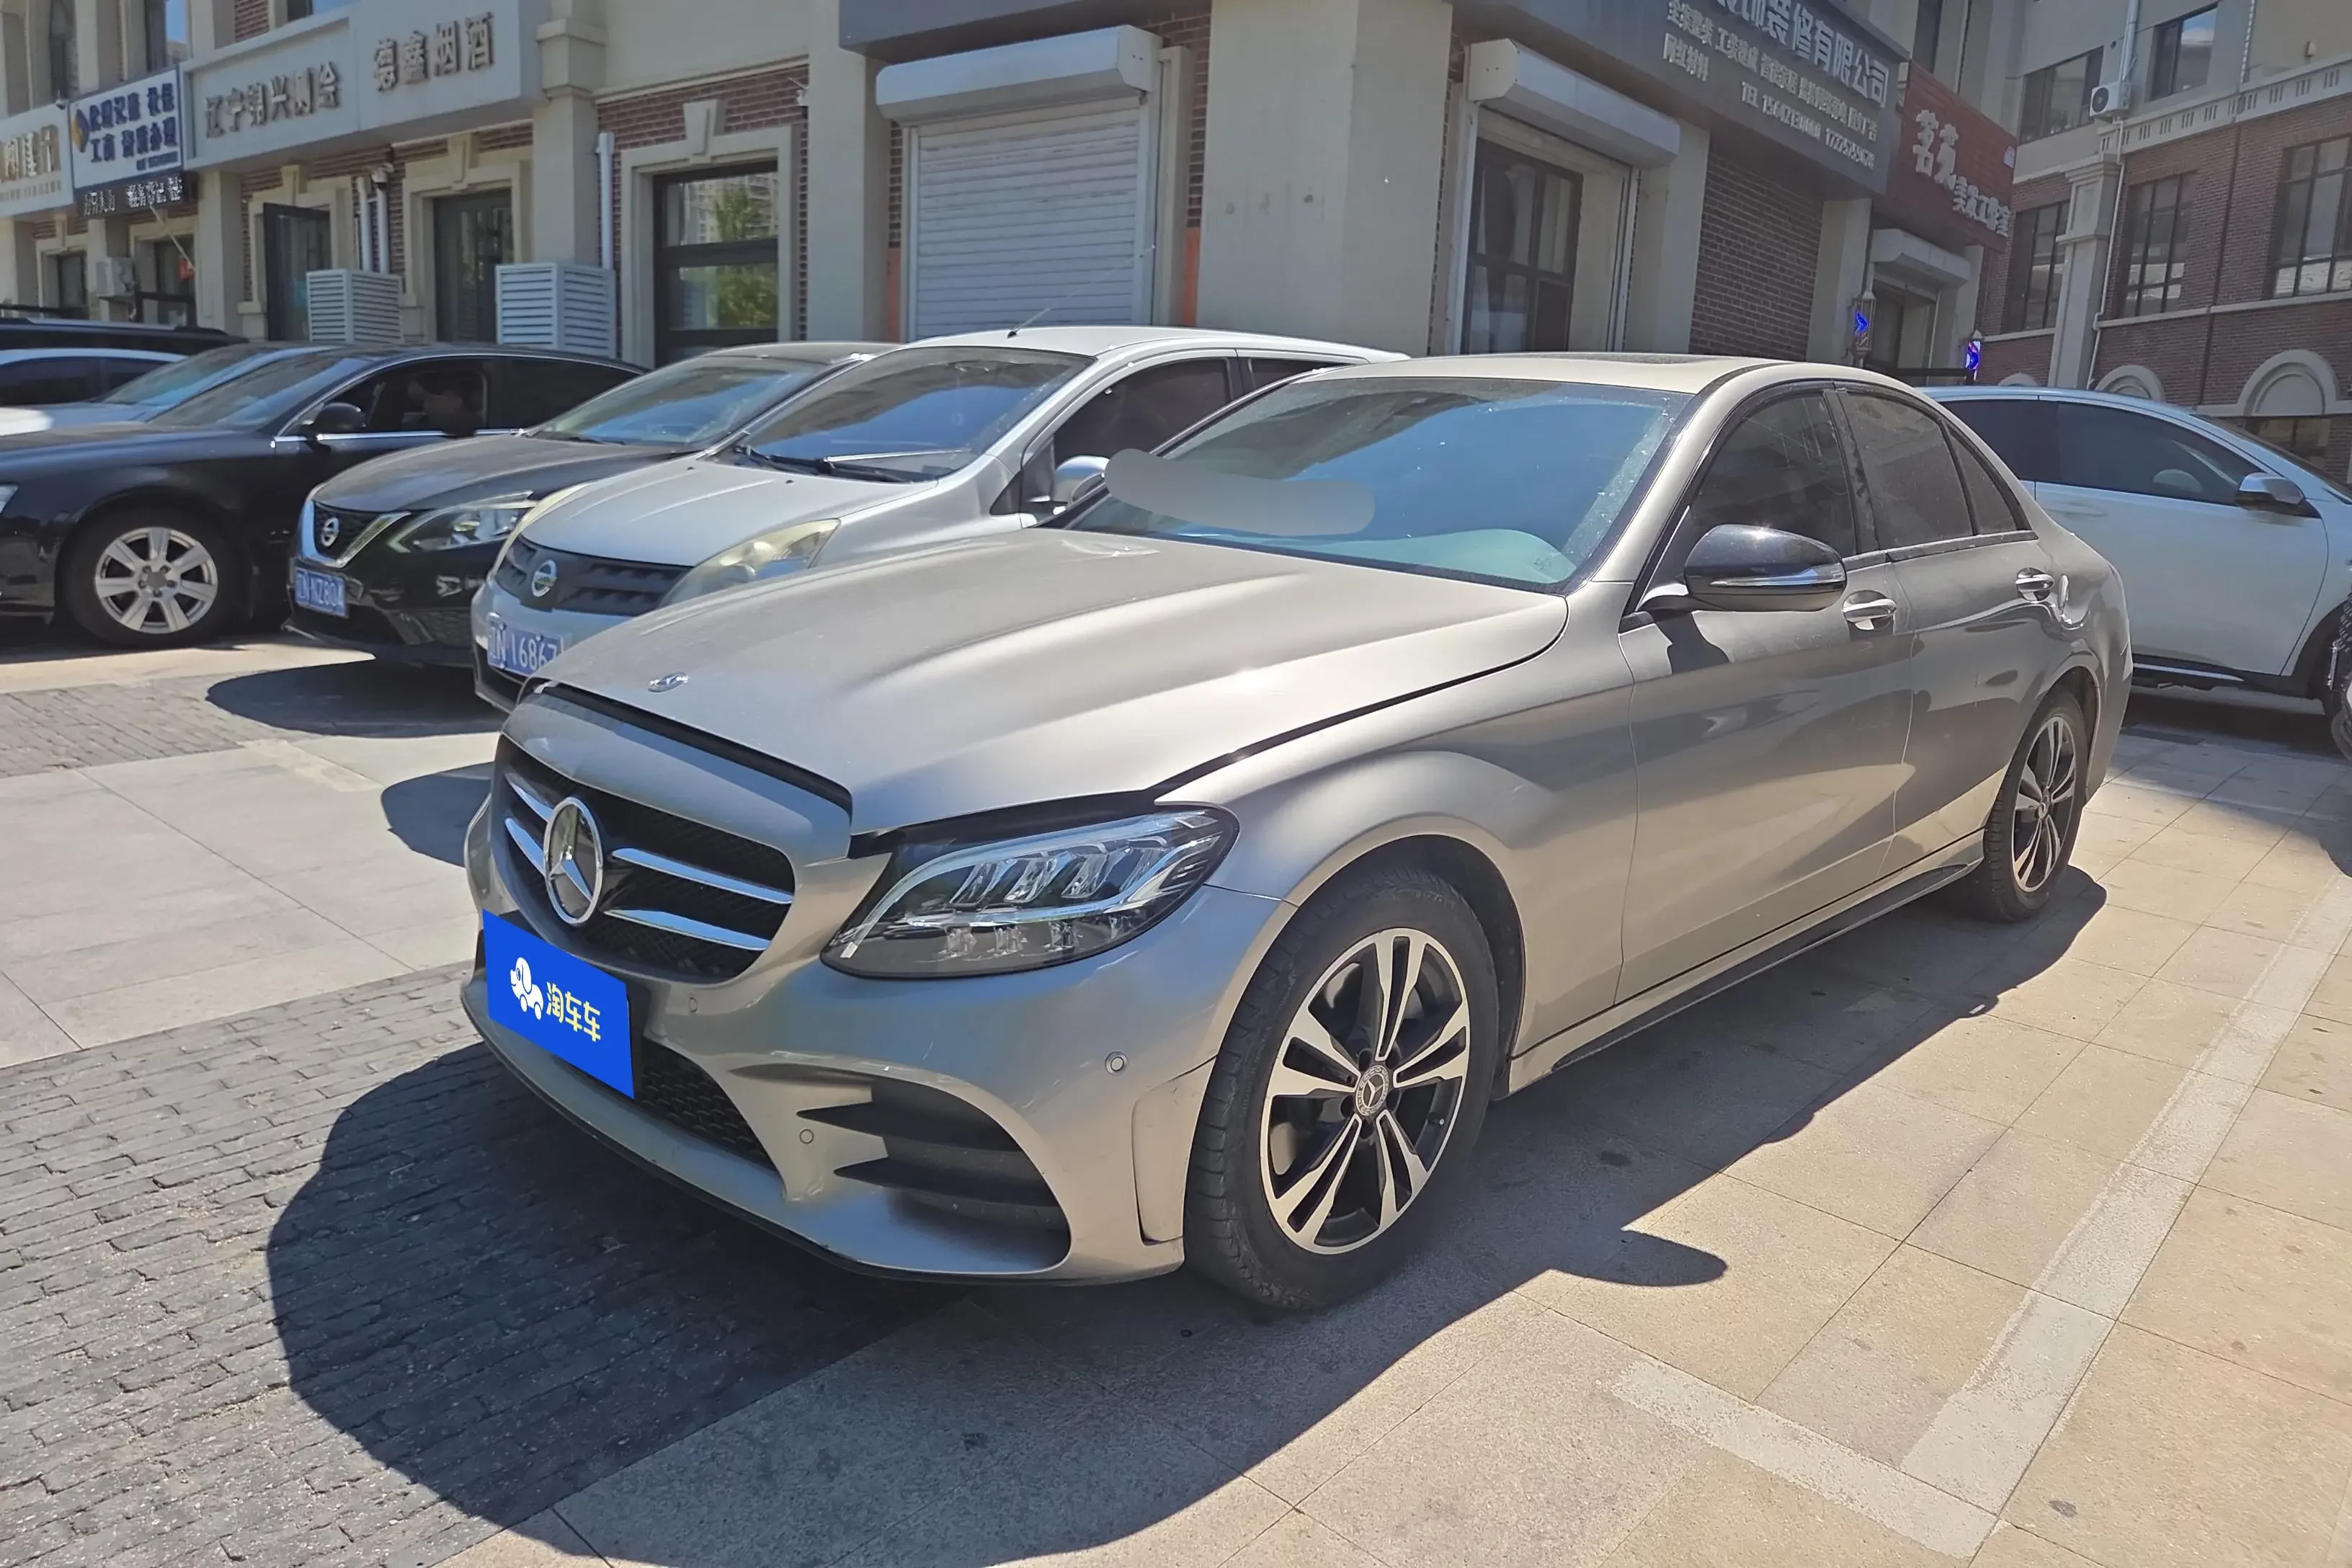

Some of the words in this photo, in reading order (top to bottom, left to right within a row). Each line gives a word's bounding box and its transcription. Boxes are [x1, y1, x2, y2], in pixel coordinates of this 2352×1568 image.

[1717, 0, 1889, 107] 装修有限公司
